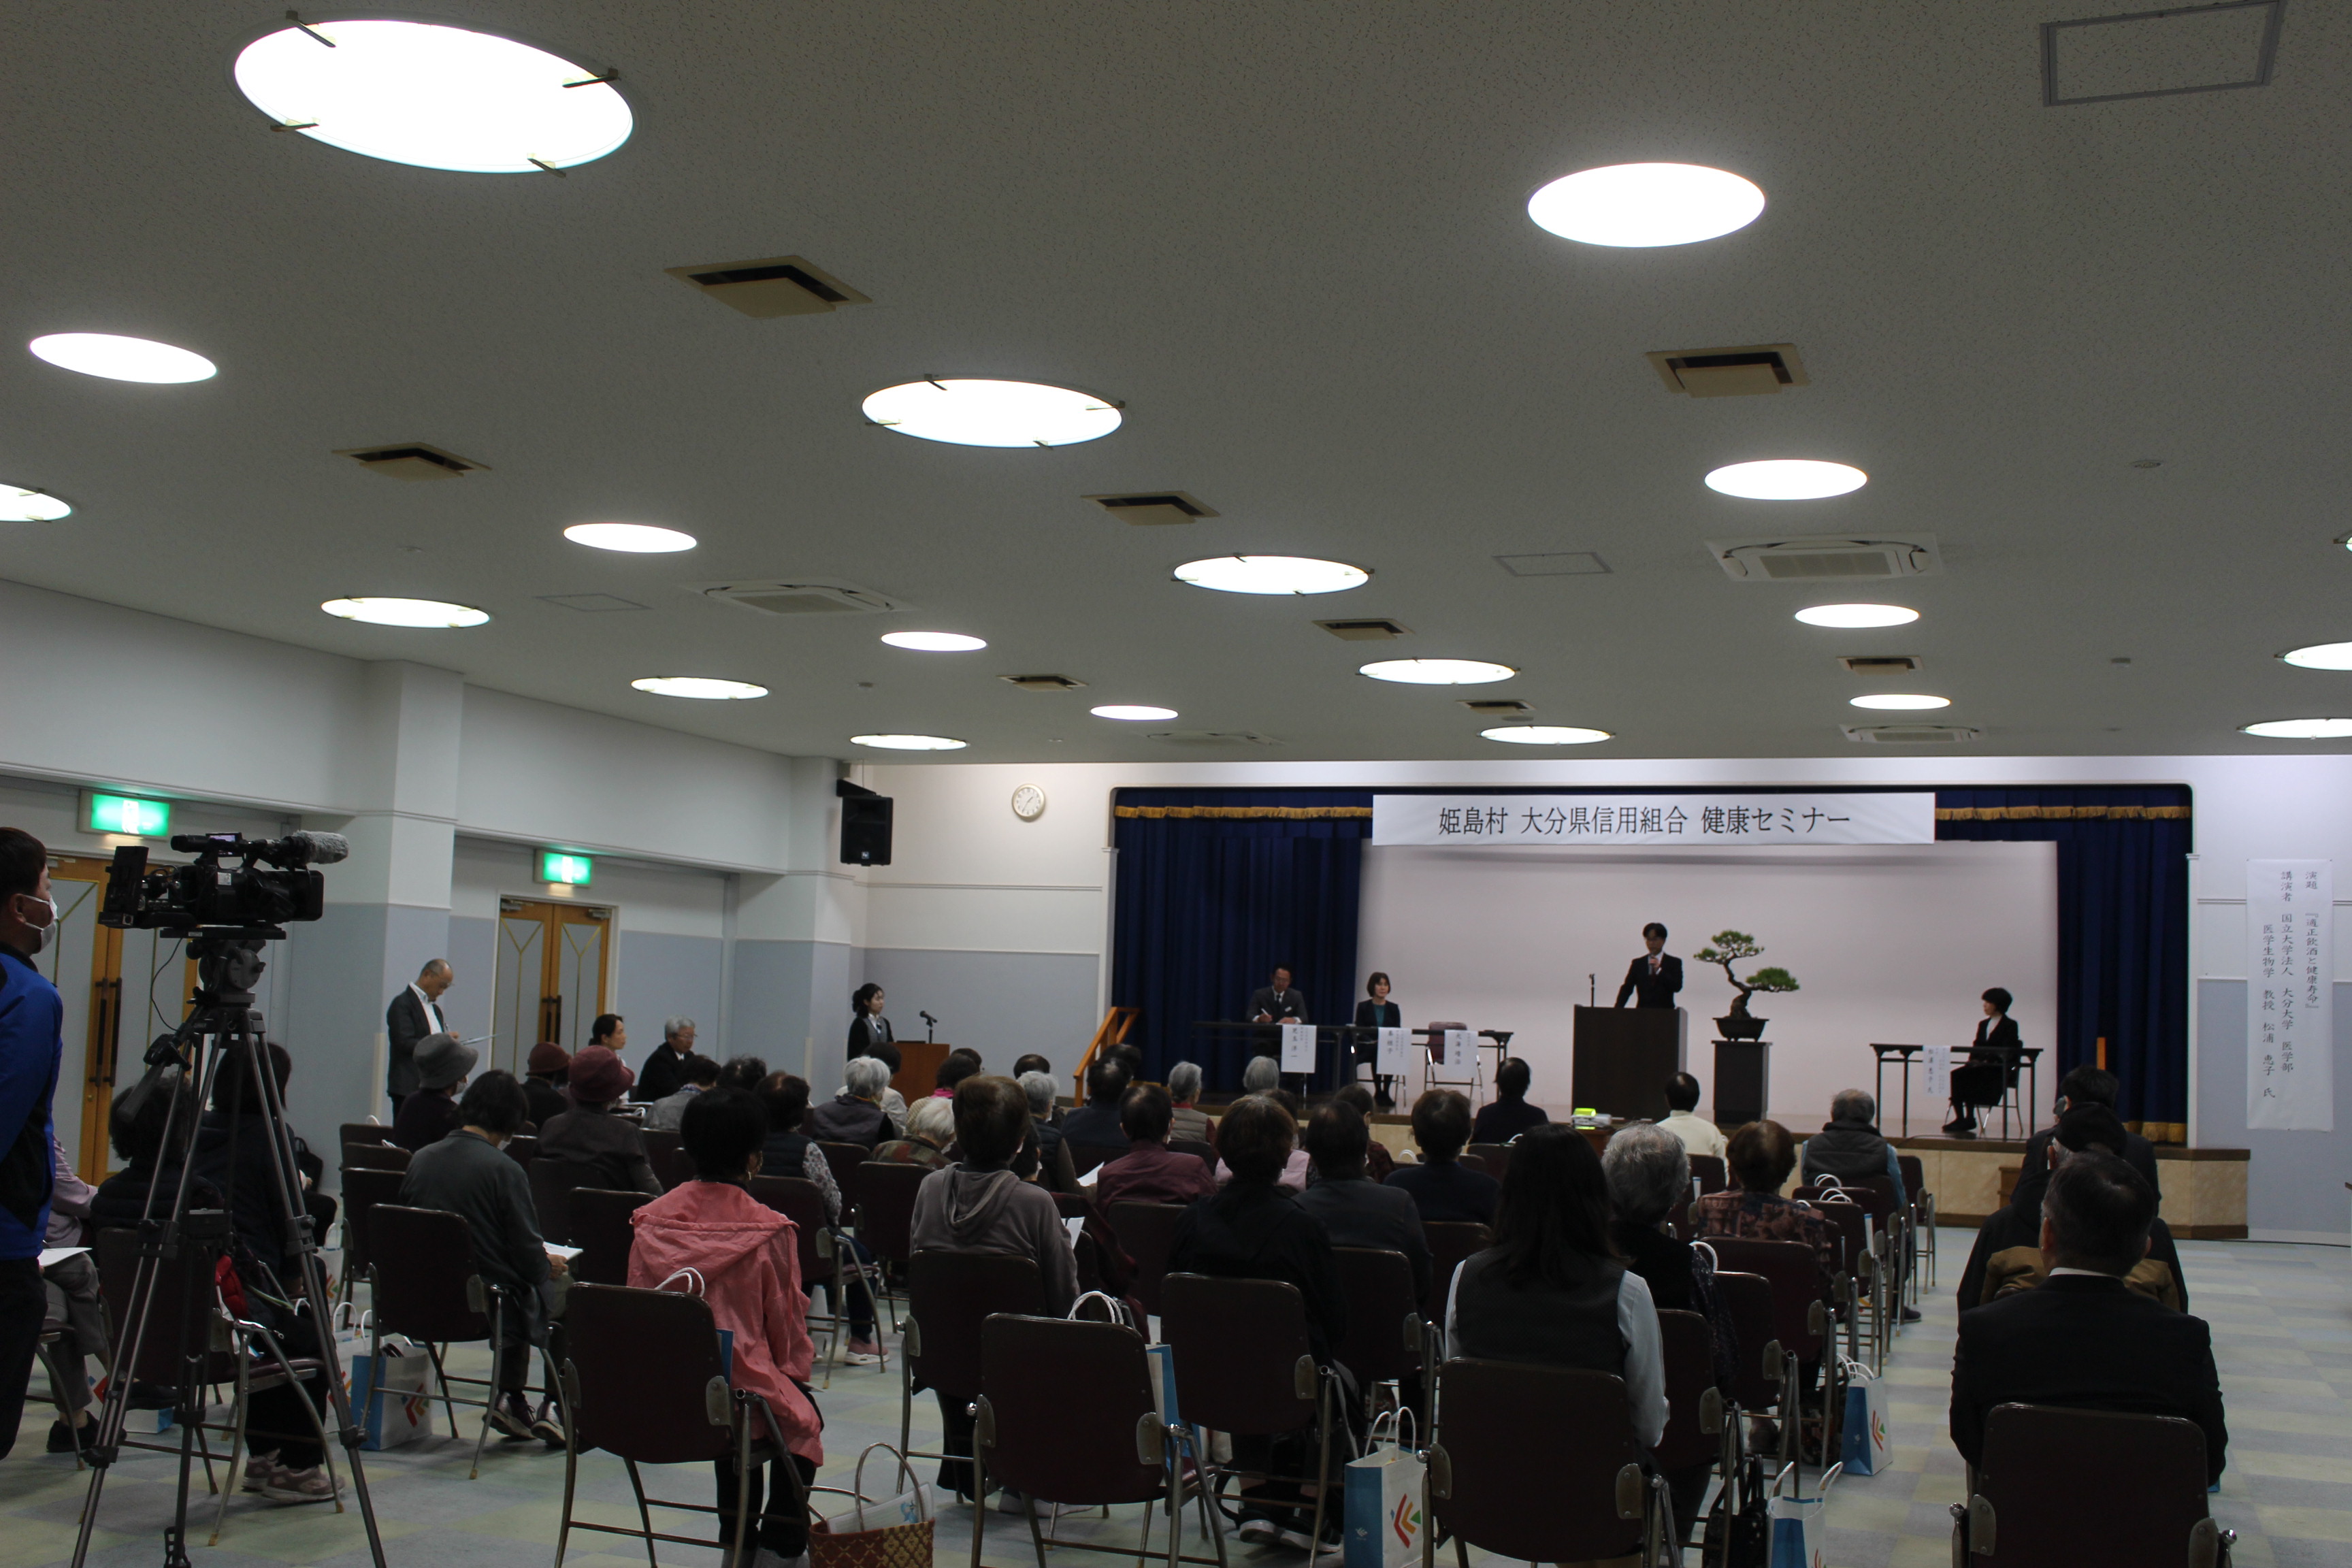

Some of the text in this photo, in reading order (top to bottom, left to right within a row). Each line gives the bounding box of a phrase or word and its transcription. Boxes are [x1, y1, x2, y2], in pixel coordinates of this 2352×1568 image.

[1439, 806, 1850, 834] 姫島村 大分県信用組合 健康セミナー
[2305, 870, 2318, 889] 演題
[2262, 924, 2274, 978] 医学生物学
[2281, 870, 2294, 1073] 講演者 国立大学法人 大分大学 医学部
[2262, 989, 2276, 1011] 教授
[2262, 1022, 2274, 1043] 松浦
[2263, 1088, 2276, 1098] 氏
